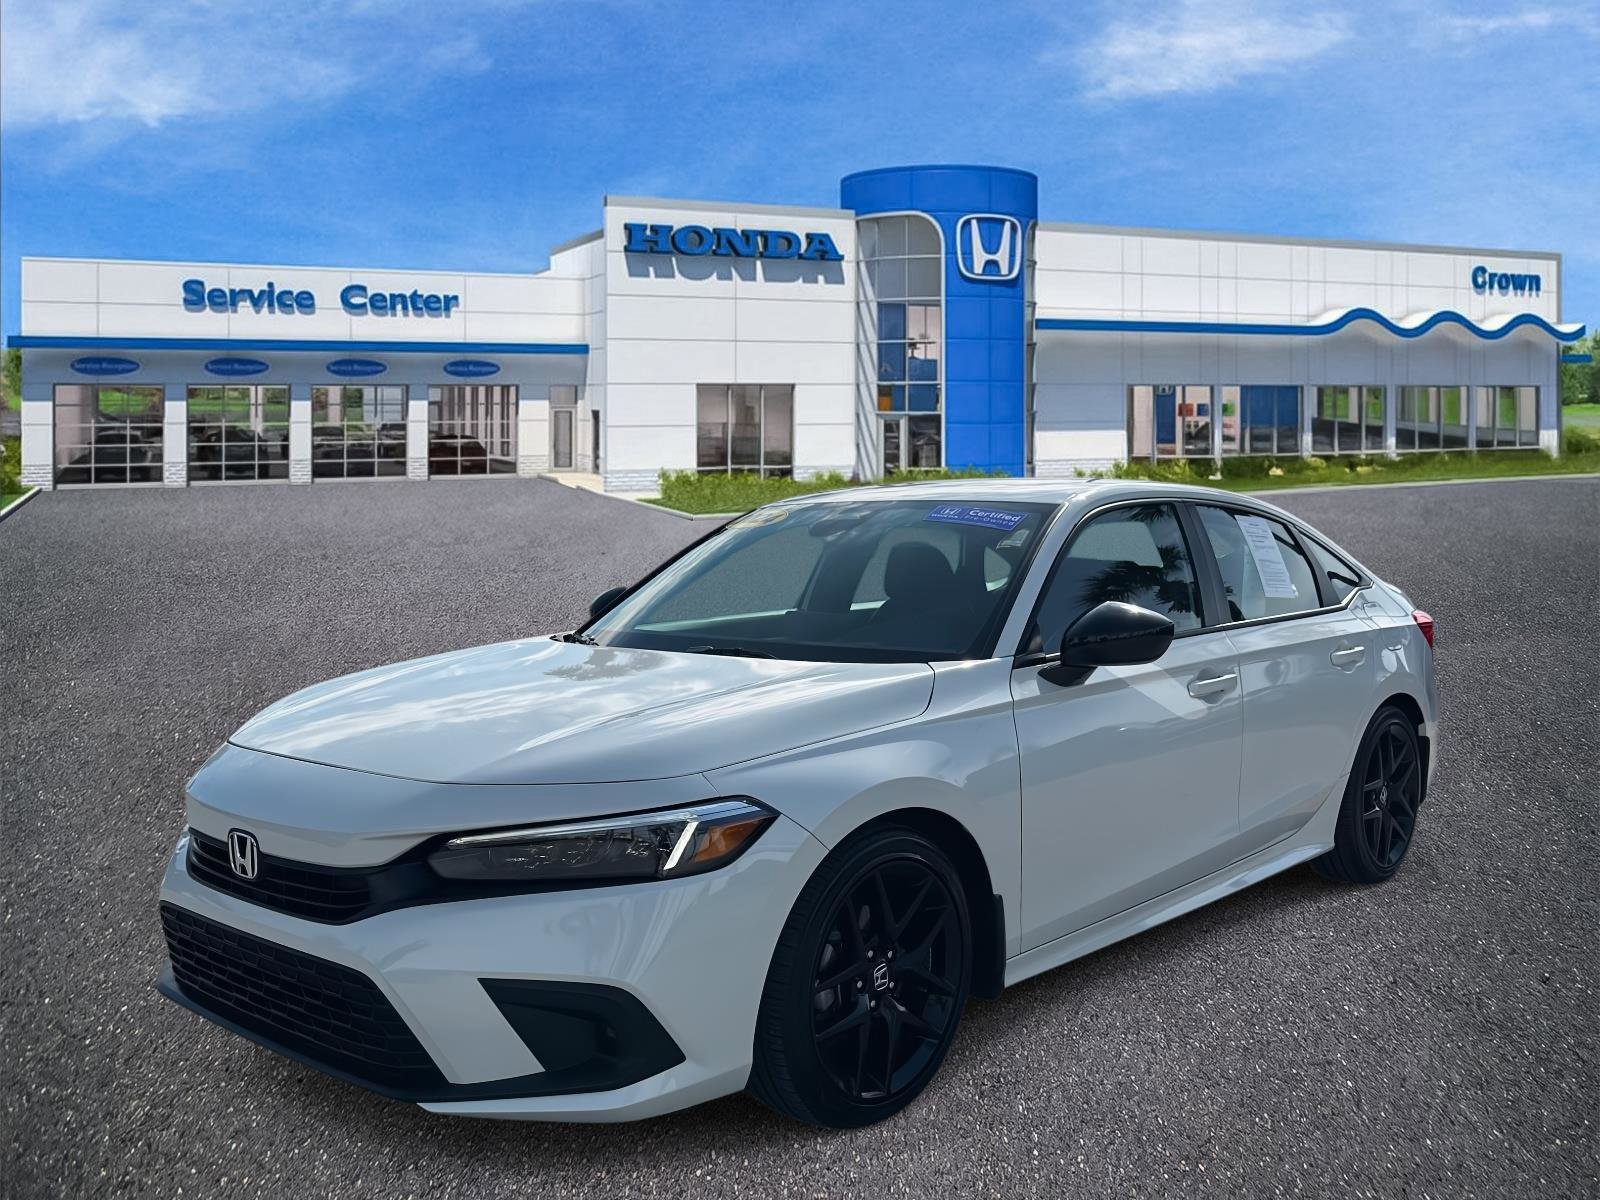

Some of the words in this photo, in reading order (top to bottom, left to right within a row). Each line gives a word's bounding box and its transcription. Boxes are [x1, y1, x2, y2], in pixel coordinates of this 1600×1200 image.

[624, 223, 844, 262] HONDA
[1471, 265, 1541, 291] Crown
[182, 279, 315, 311] Service
[340, 284, 460, 314] Center
[969, 509, 1021, 522] Certified
